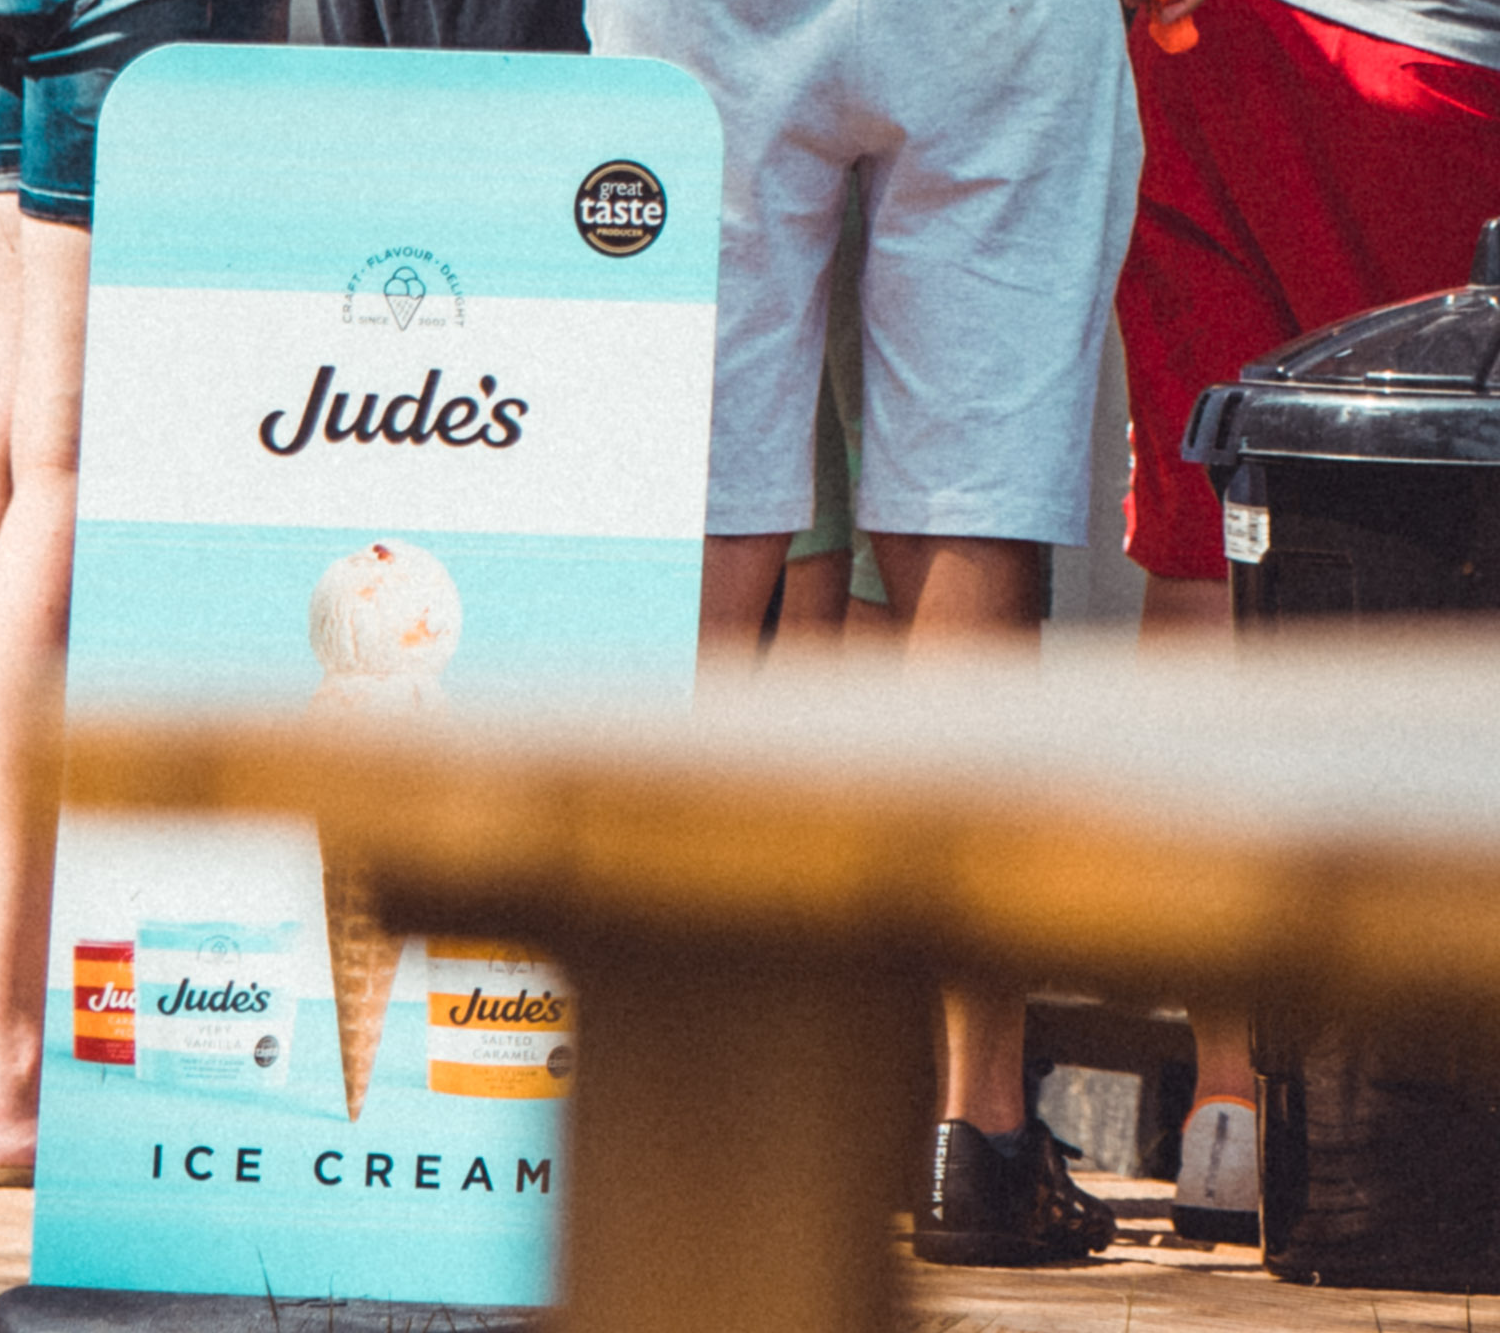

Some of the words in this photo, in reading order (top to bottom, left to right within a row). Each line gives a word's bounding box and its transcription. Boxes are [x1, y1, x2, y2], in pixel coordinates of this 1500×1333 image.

[599, 180, 644, 201] great
[580, 196, 663, 227] taste
[341, 272, 362, 325] CRAFT
[366, 245, 435, 270] FLAVOUR
[440, 263, 466, 328] DELIGHT
[258, 364, 530, 457] Jude's
[157, 977, 271, 1016] Jude's
[449, 986, 566, 1026] Jude's
[472, 1048, 539, 1062] CARAMEL
[480, 1034, 533, 1047] SALTED
[152, 1143, 263, 1183] ICE
[313, 1150, 552, 1194] CREAM
